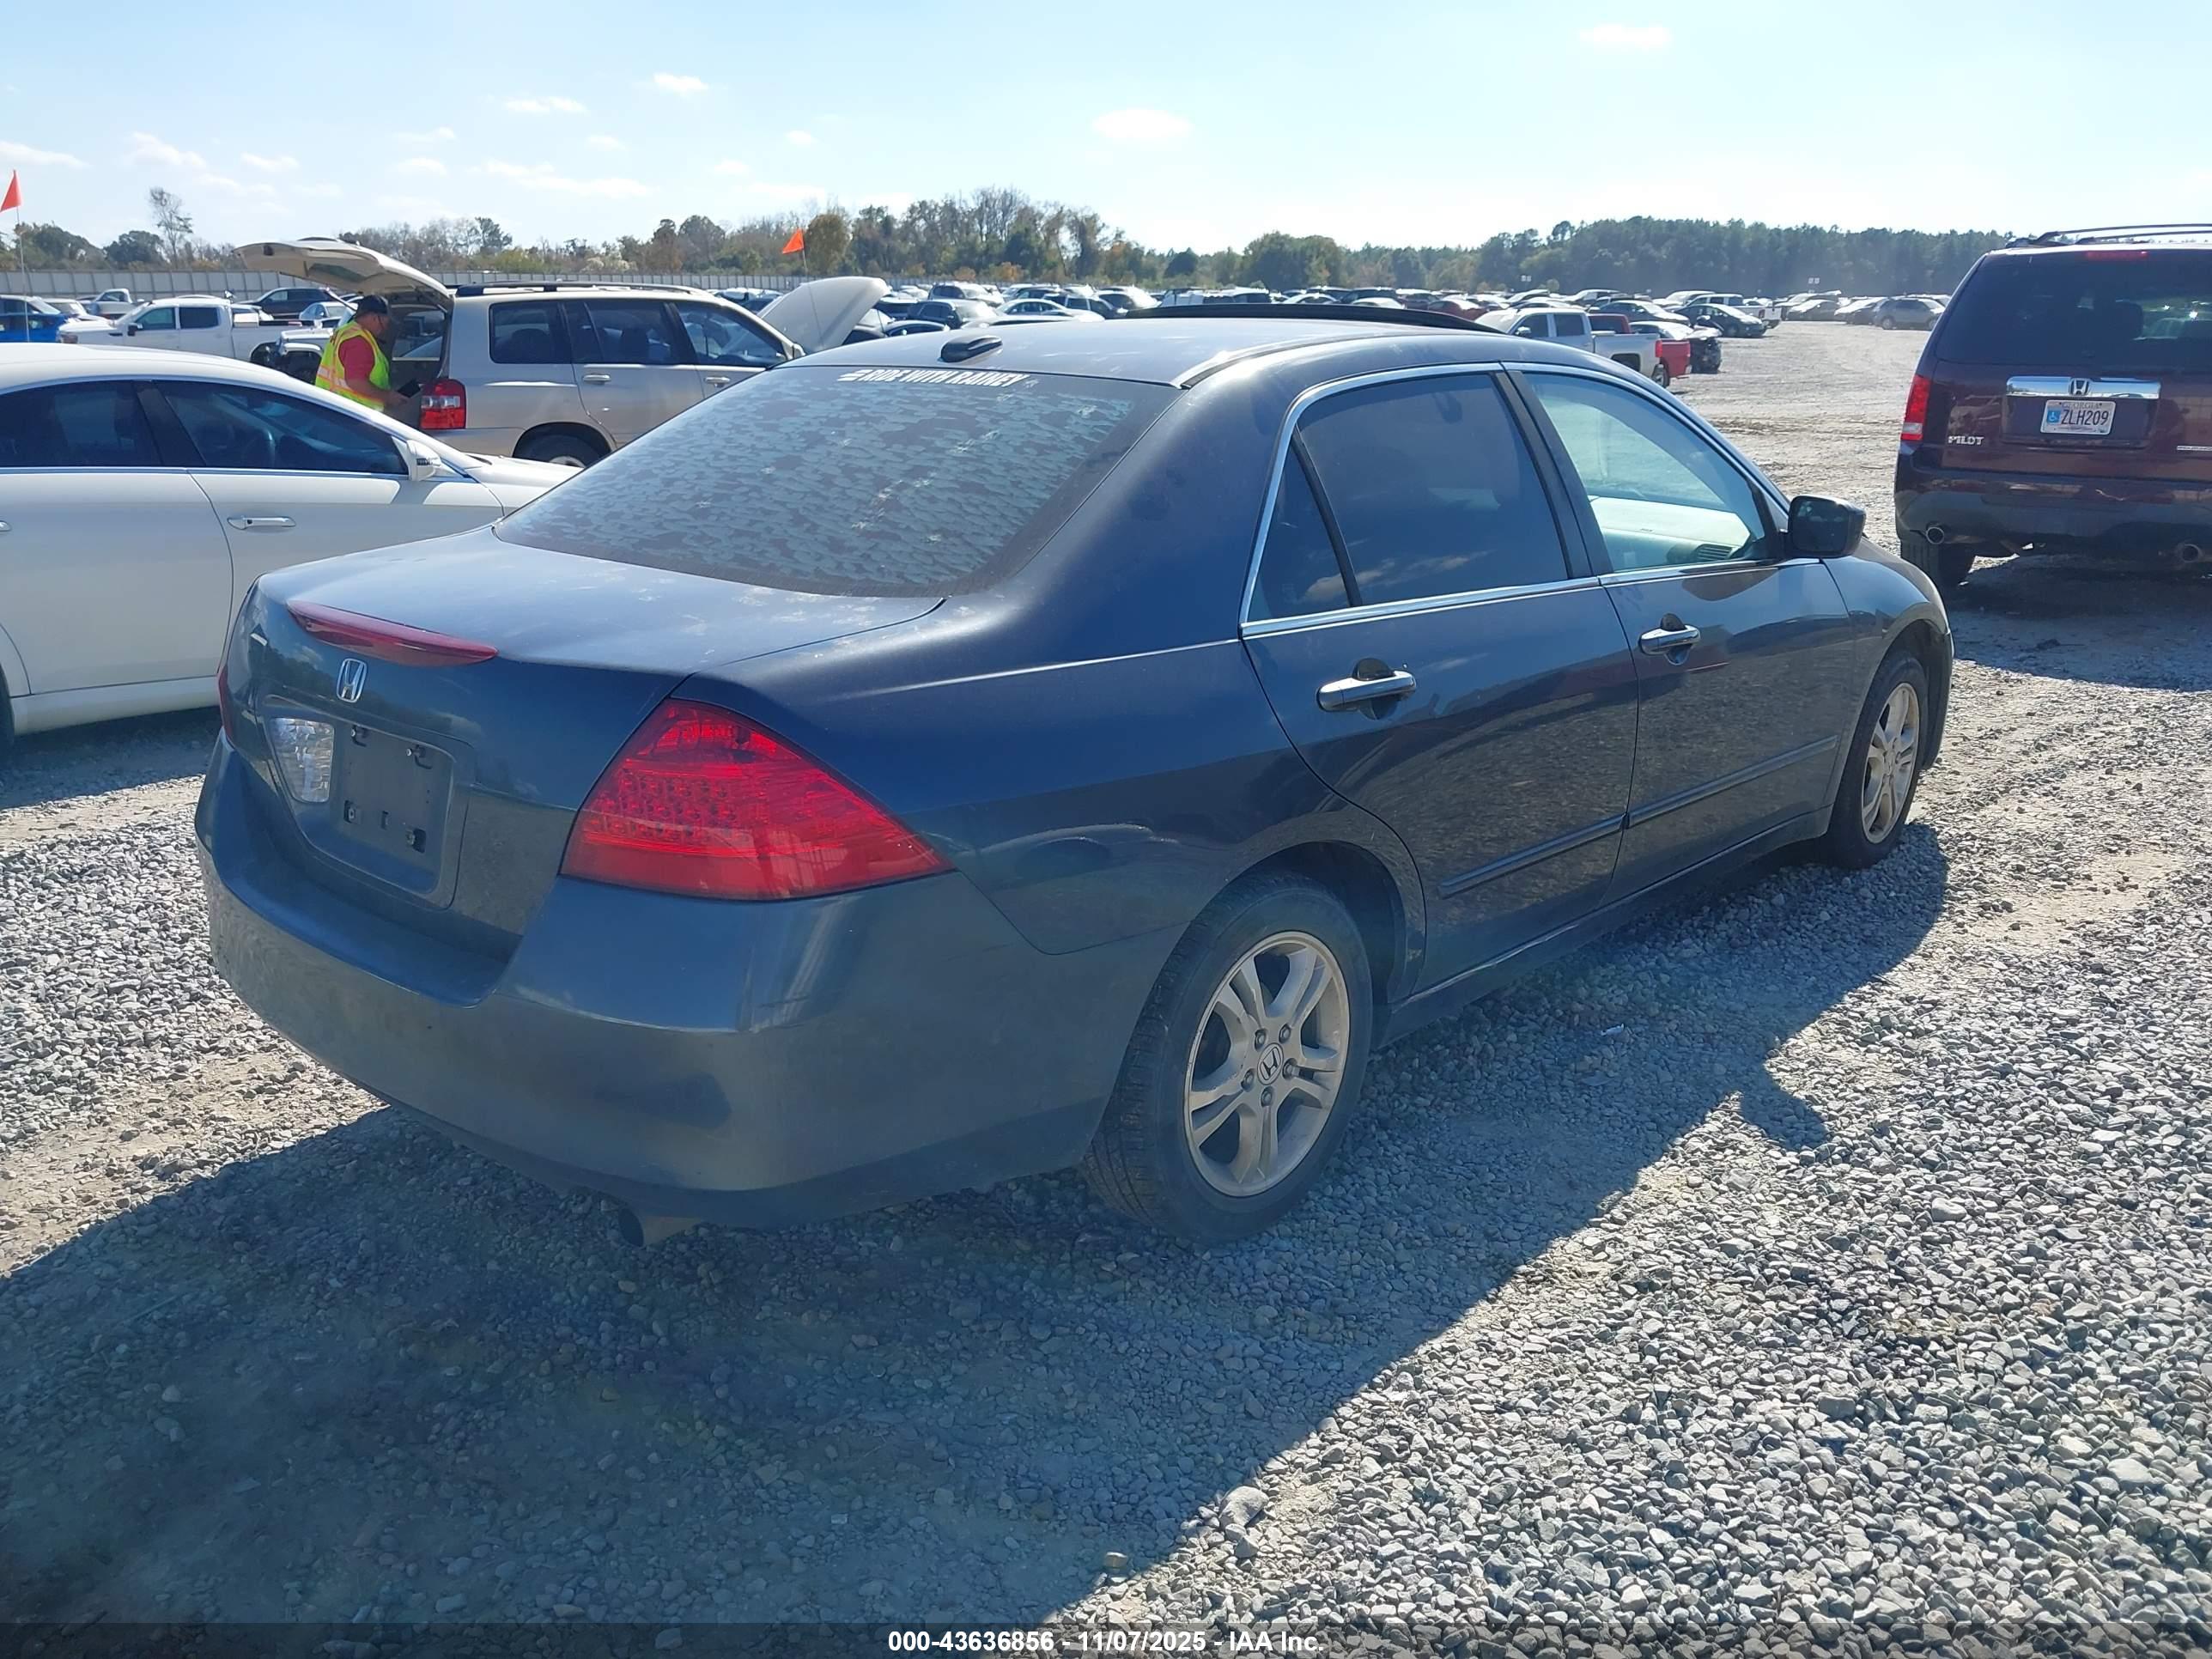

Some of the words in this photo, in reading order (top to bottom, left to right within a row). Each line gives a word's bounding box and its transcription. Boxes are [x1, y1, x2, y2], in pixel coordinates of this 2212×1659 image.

[857, 369, 912, 382] RIDE
[898, 370, 959, 384] WITH
[945, 371, 1030, 387] RAINEY
[2061, 409, 2109, 426] ZLH209
[1948, 435, 1984, 445] PILOT
